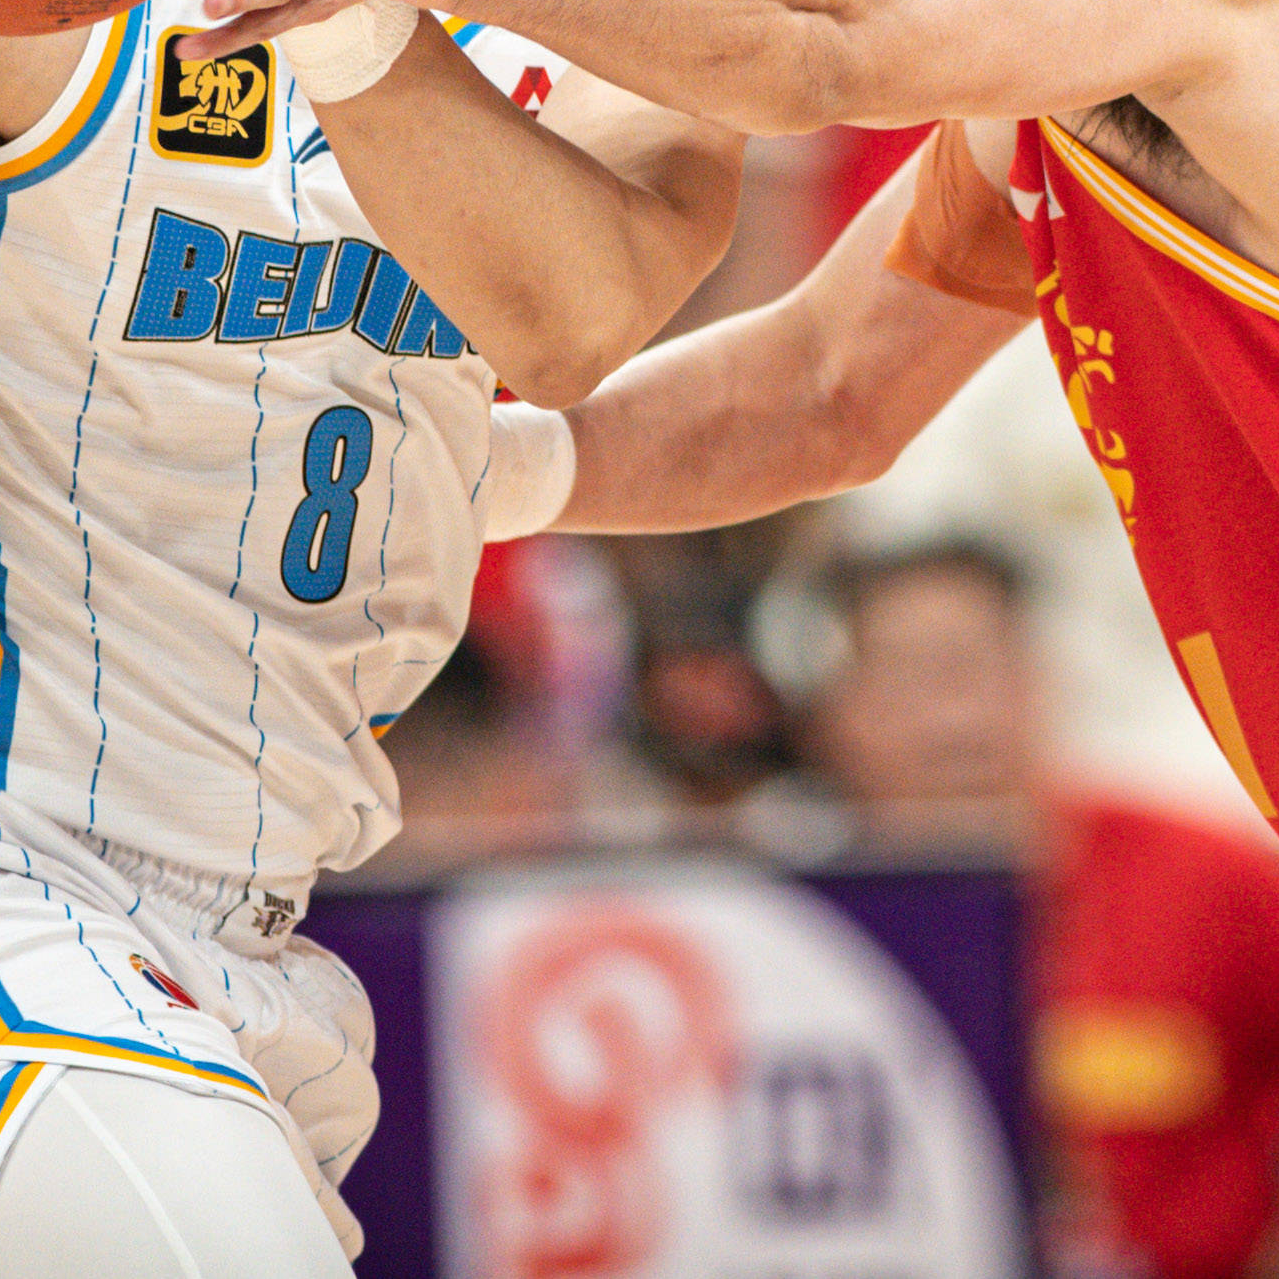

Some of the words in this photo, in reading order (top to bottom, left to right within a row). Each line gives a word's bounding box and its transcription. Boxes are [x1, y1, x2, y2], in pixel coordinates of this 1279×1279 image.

[187, 114, 249, 139] CBA
[123, 207, 480, 359] BEIJIN
[281, 404, 373, 604] 8
